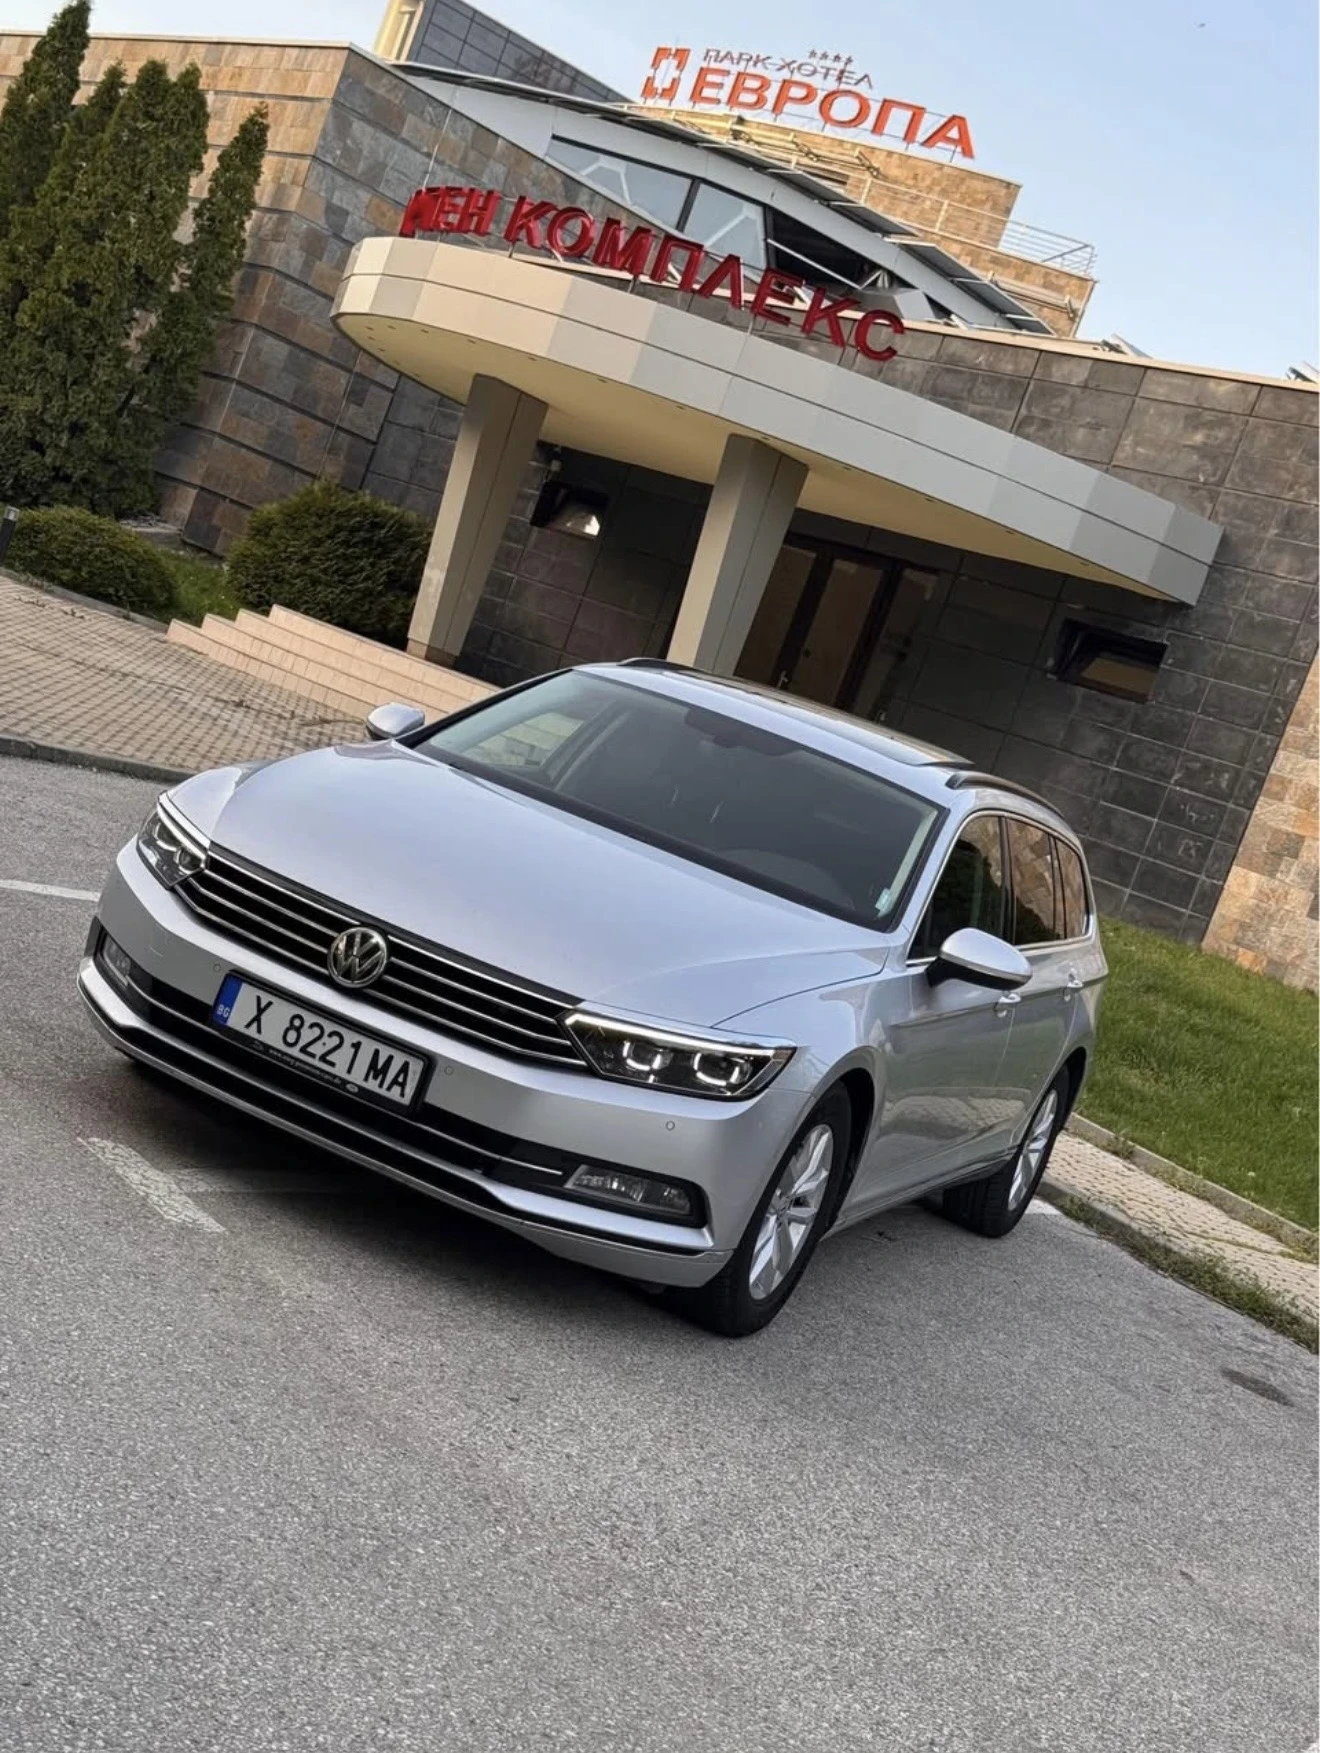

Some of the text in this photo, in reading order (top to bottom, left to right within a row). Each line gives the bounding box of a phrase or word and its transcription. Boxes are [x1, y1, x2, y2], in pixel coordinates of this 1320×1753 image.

[690, 67, 975, 159] ЕВРОПА
[503, 195, 904, 361] КОМПЛЕКС
[217, 1003, 230, 1018] BG
[245, 995, 273, 1035] X
[282, 1014, 362, 1075] 8221
[363, 1048, 411, 1098] MA
